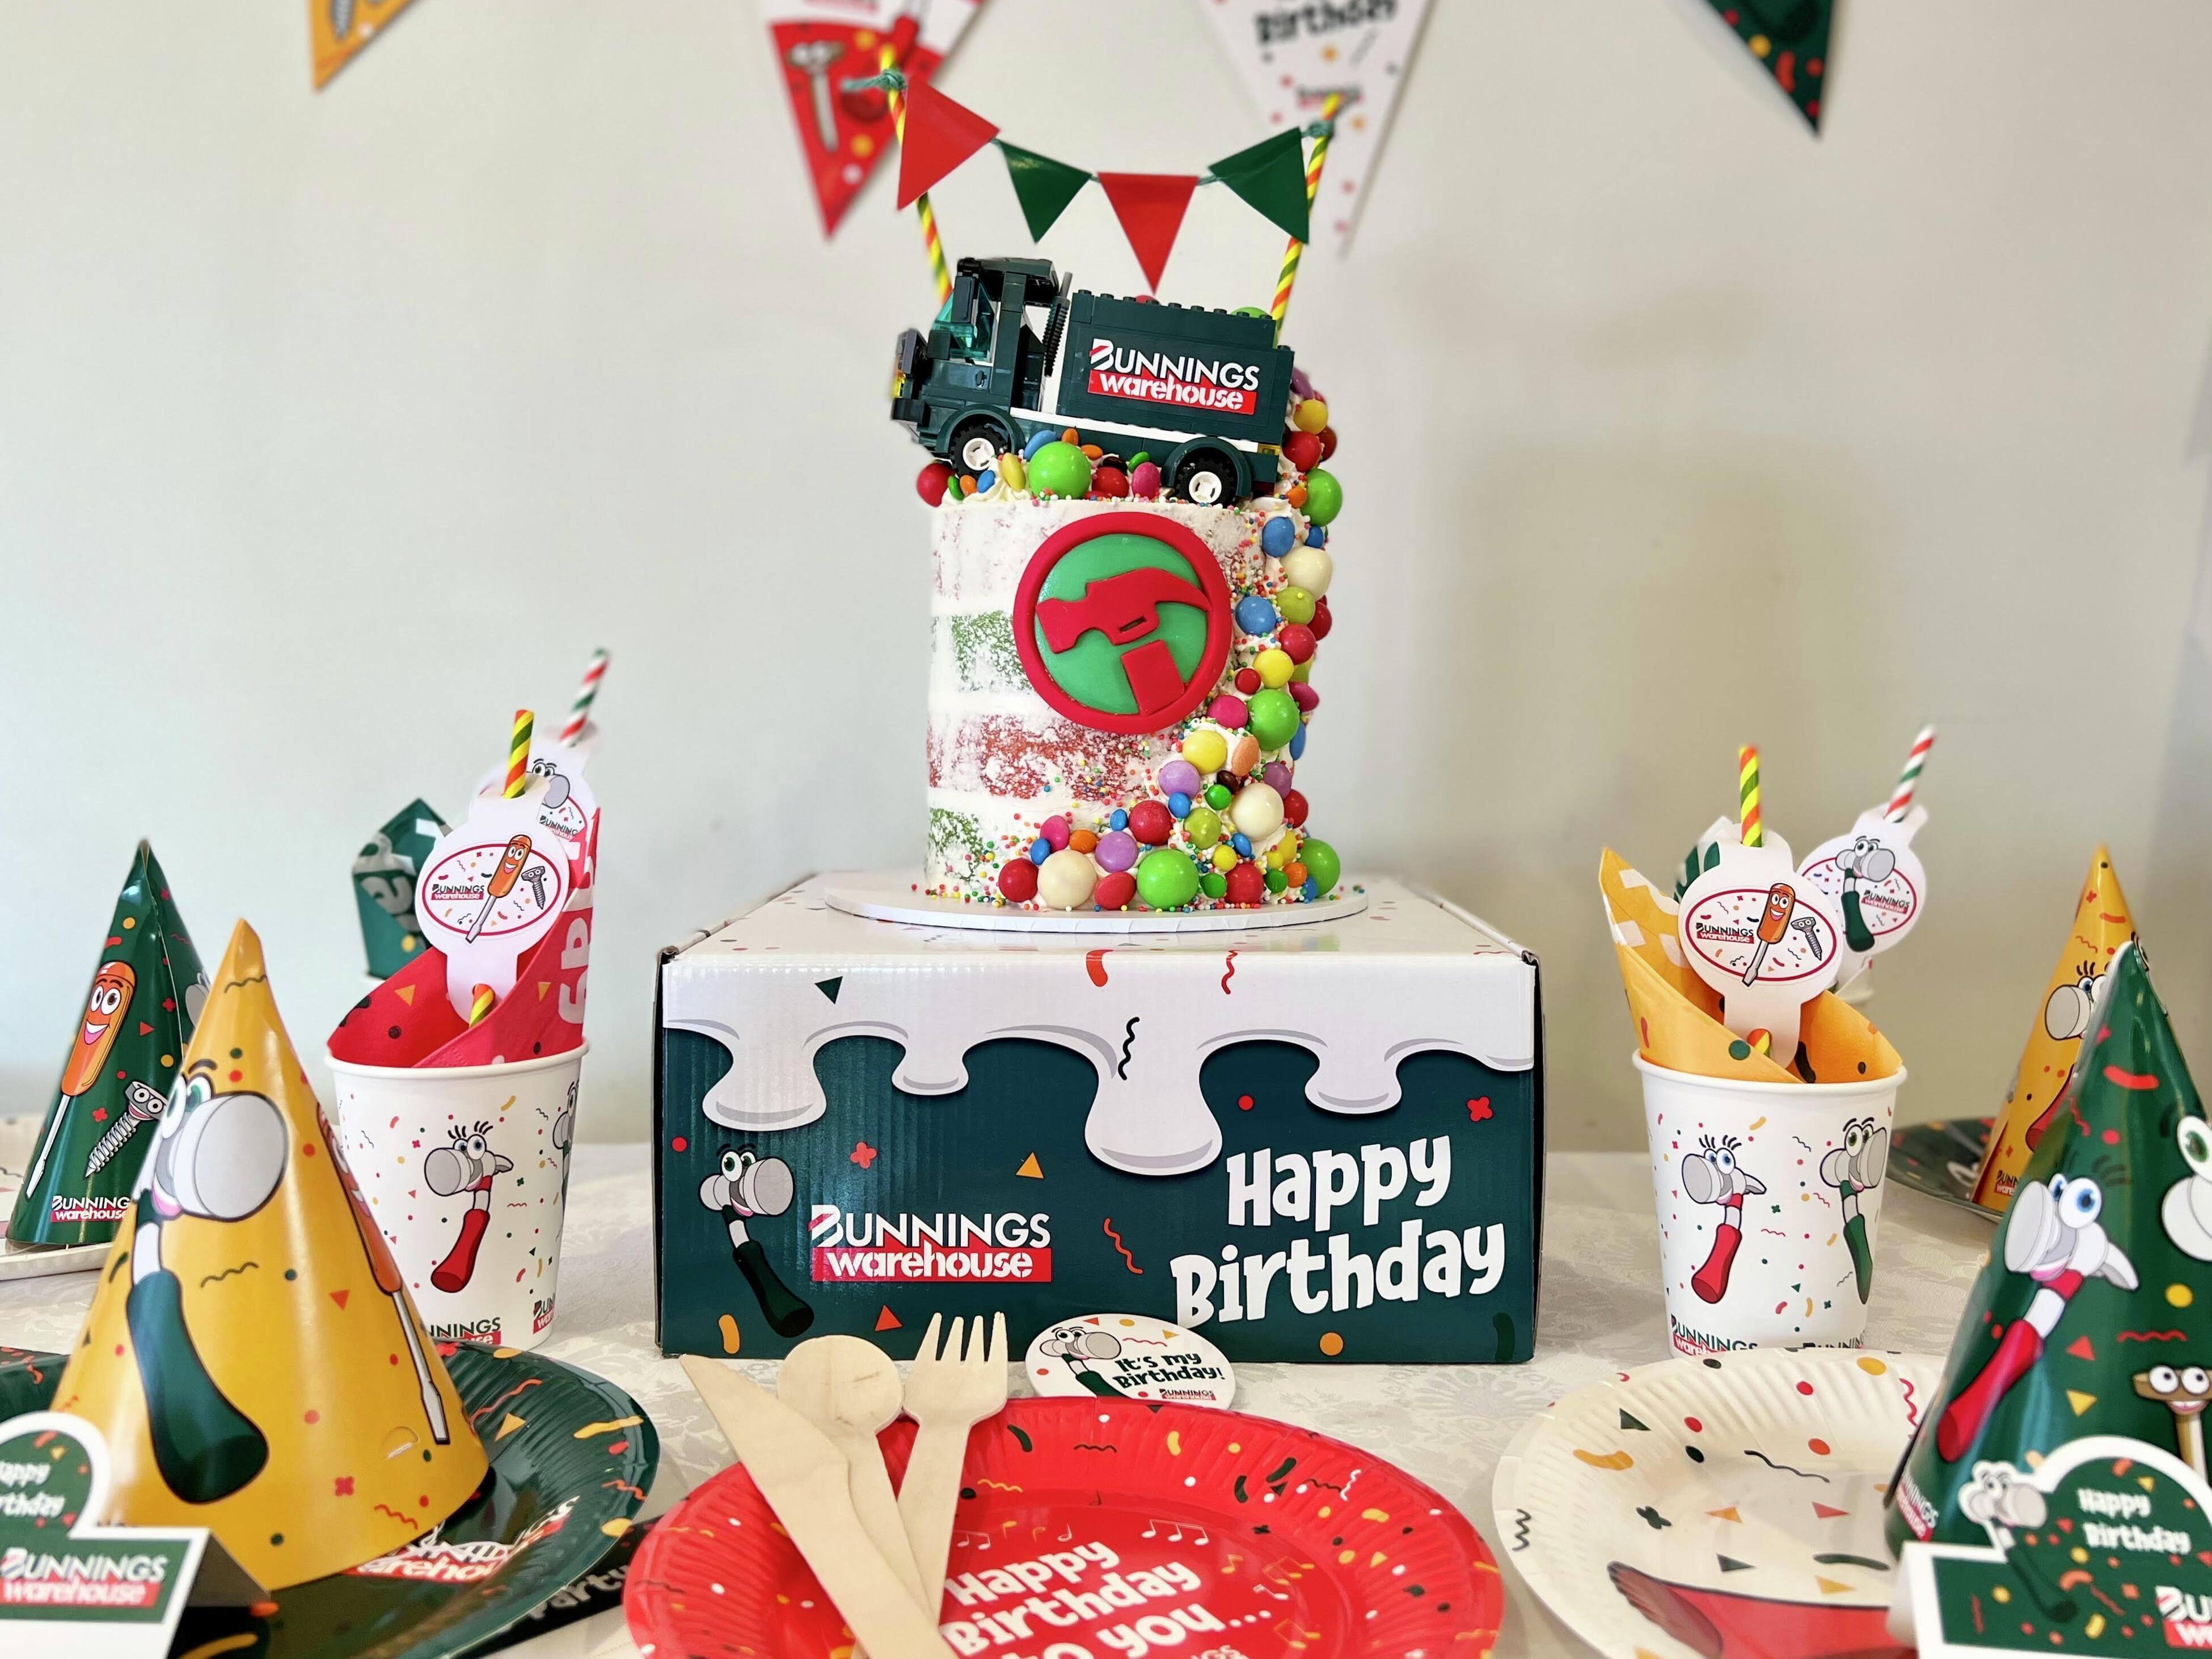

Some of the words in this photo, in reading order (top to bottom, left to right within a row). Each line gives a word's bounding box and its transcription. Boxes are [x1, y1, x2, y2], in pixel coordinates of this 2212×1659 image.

[1089, 339, 1260, 391] BUNNINGS
[1100, 372, 1244, 410] warehouse
[432, 884, 484, 893] BUNNINGS
[434, 892, 480, 900] warehouse
[1864, 889, 1910, 908] BUNNINGS
[1696, 922, 1754, 937] BUNNINGS
[1700, 932, 1750, 943] warehouse
[1226, 1135, 1451, 1232] Happy
[807, 1204, 1051, 1248] BUNNINGS
[826, 1239, 1033, 1278] warehouse
[1170, 1218, 1505, 1329] Birthday
[1112, 1366, 1226, 1389] Birthday!
[1115, 1356, 1159, 1373] It's
[1160, 1353, 1202, 1366] my
[0, 1459, 52, 1487] appy
[2077, 1488, 2152, 1519] Happy
[2083, 1522, 2192, 1555] Birthday
[1, 1547, 168, 1582] BUNNINGS
[943, 1541, 1120, 1606] Happy
[939, 1561, 1201, 1656] Birthday
[1096, 1603, 1272, 1658] you...
